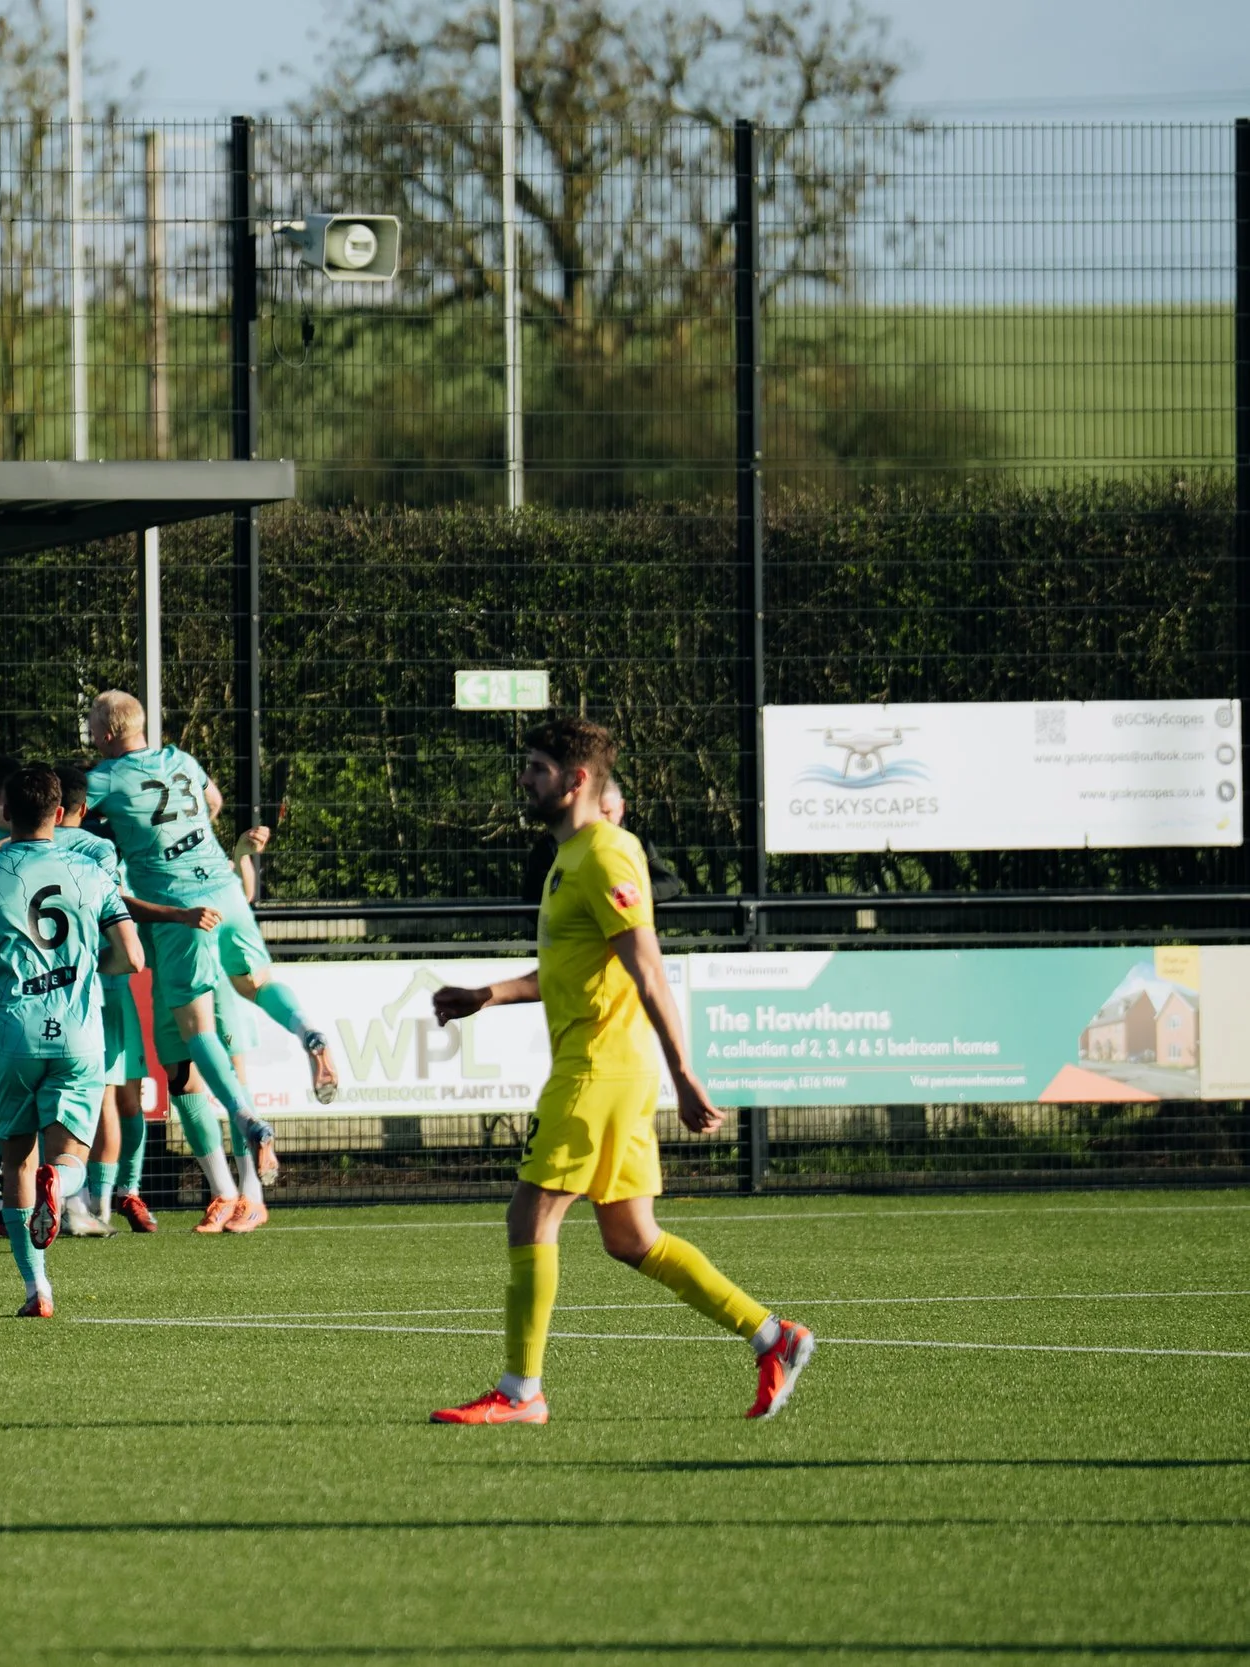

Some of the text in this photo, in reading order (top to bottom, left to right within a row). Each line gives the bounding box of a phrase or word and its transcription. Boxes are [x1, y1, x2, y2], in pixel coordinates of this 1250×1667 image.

[140, 772, 199, 826] 23
[788, 797, 940, 816] GC SKYSCAPES
[27, 884, 70, 950] 6
[26, 969, 72, 994] IREN
[706, 1002, 892, 1032] The Hawthorns
[335, 1016, 501, 1082] WPL
[707, 1037, 1000, 1059] A collection of 2, 3, 4 & 5 bedroom homes
[441, 1085, 495, 1100] PLANT
[498, 1084, 531, 1099] LTD
[707, 1077, 738, 1090] Market
